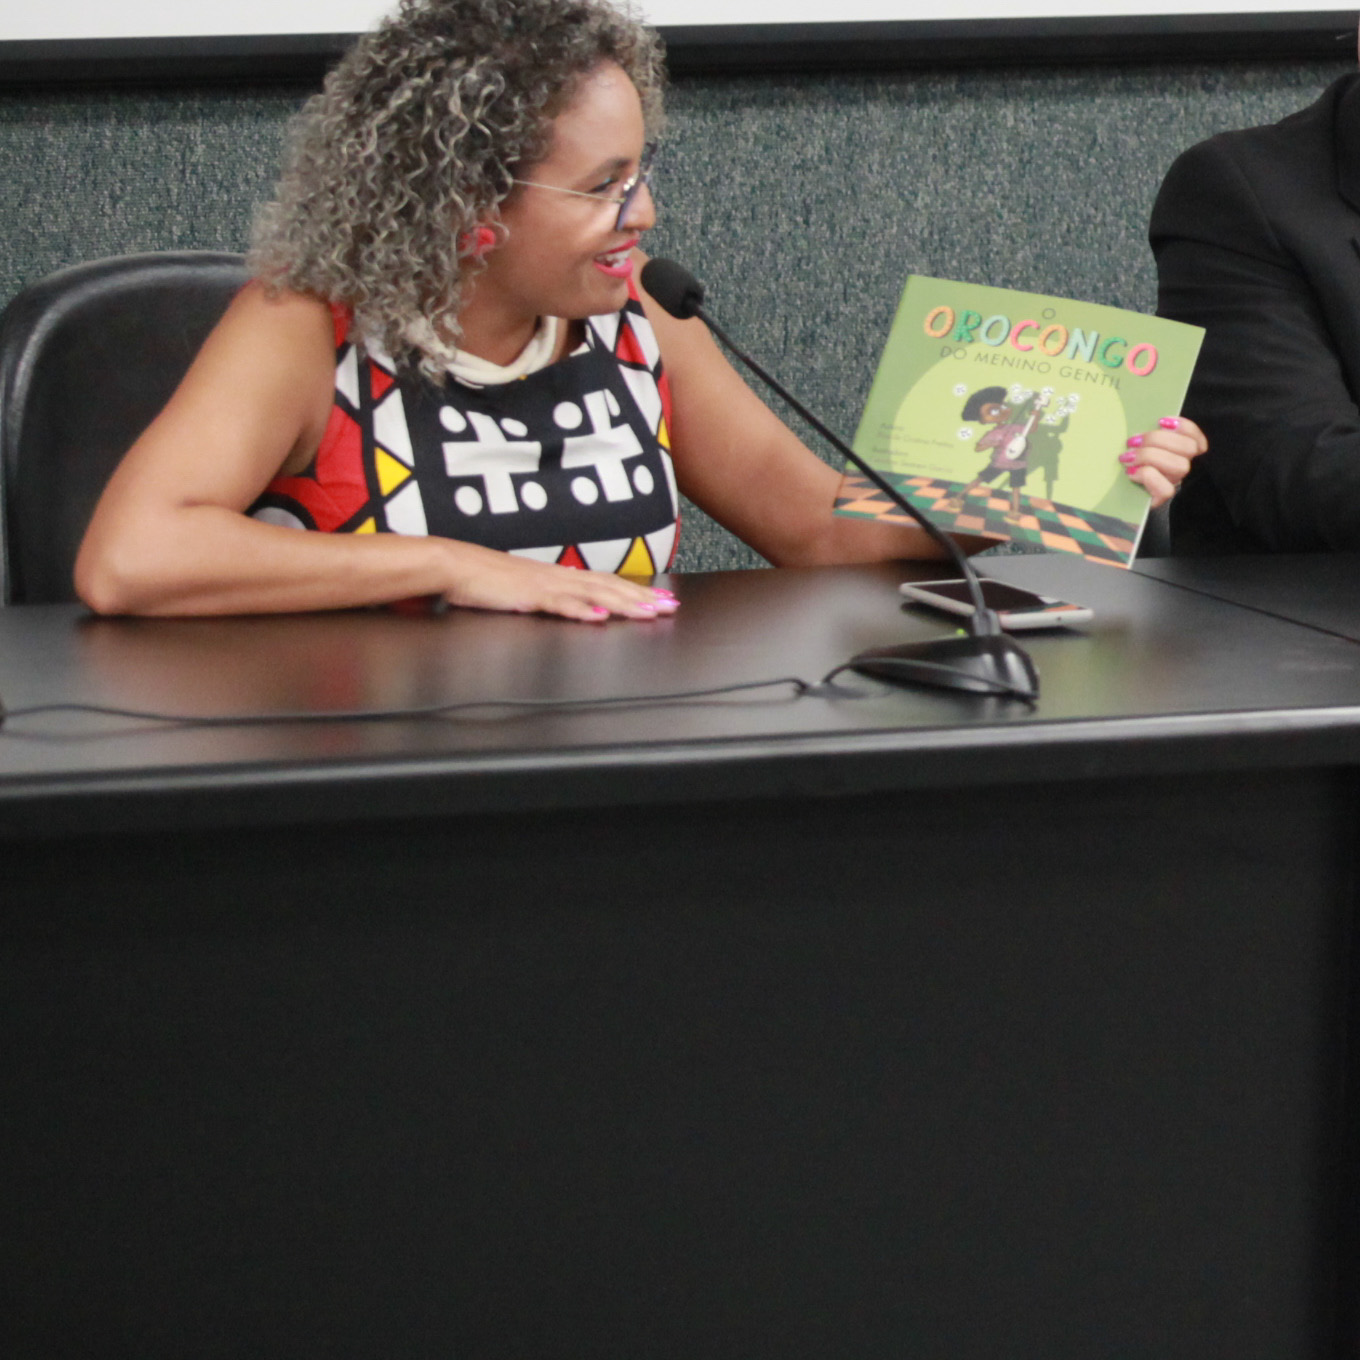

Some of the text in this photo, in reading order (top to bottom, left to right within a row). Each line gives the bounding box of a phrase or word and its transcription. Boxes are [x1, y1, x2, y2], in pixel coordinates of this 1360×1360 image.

[1041, 307, 1057, 320] O
[924, 305, 1159, 377] OROCONGO
[940, 345, 1121, 391] DO MENINO GENTIL
